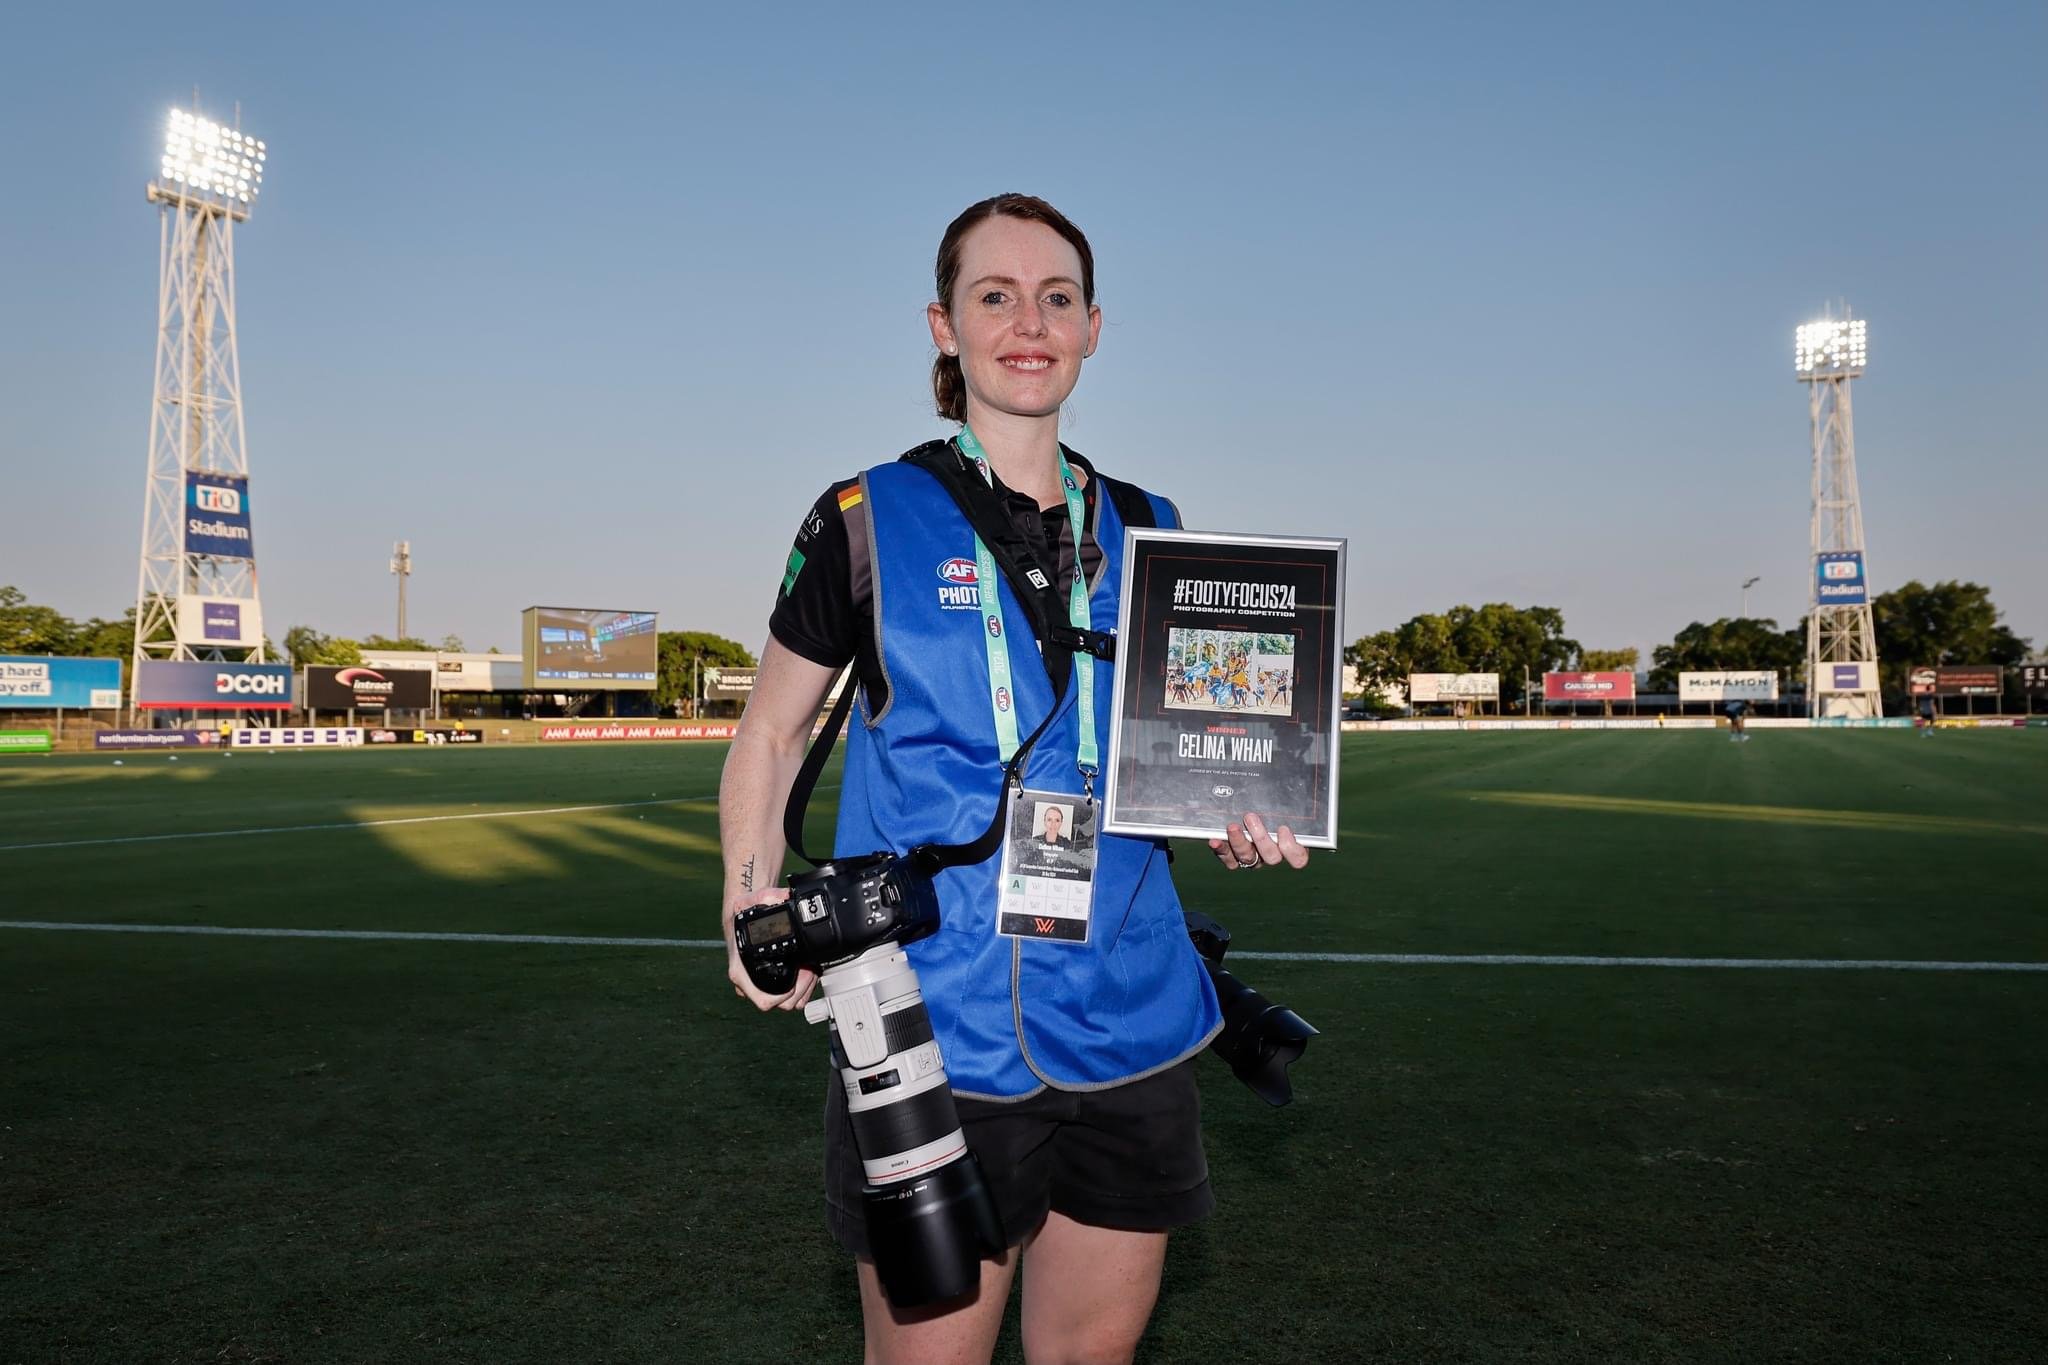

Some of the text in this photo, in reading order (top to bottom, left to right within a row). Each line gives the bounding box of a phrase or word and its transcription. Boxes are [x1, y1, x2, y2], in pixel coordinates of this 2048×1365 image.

[189, 519, 248, 540] Stadium
[938, 586, 980, 605] PHOT
[1173, 578, 1296, 610] #FOOTYFOCUS24
[1821, 584, 1864, 596] Stadium
[1173, 604, 1296, 618] PHOTOGRAPHY COMPETITION
[988, 617, 1000, 636] AFL
[7, 664, 42, 676] hard
[721, 675, 753, 685] BRIDGE
[1564, 682, 1597, 690] CARLTON
[998, 689, 1009, 711] AFL
[546, 728, 728, 738] AAMI AAMI AAMI AAMI AAMI AAMI AAMI
[1179, 733, 1273, 763] CELINA WHAN
[1214, 787, 1232, 795] AFL
[1012, 880, 1020, 888] A
[890, 1160, 909, 1168] Canon
